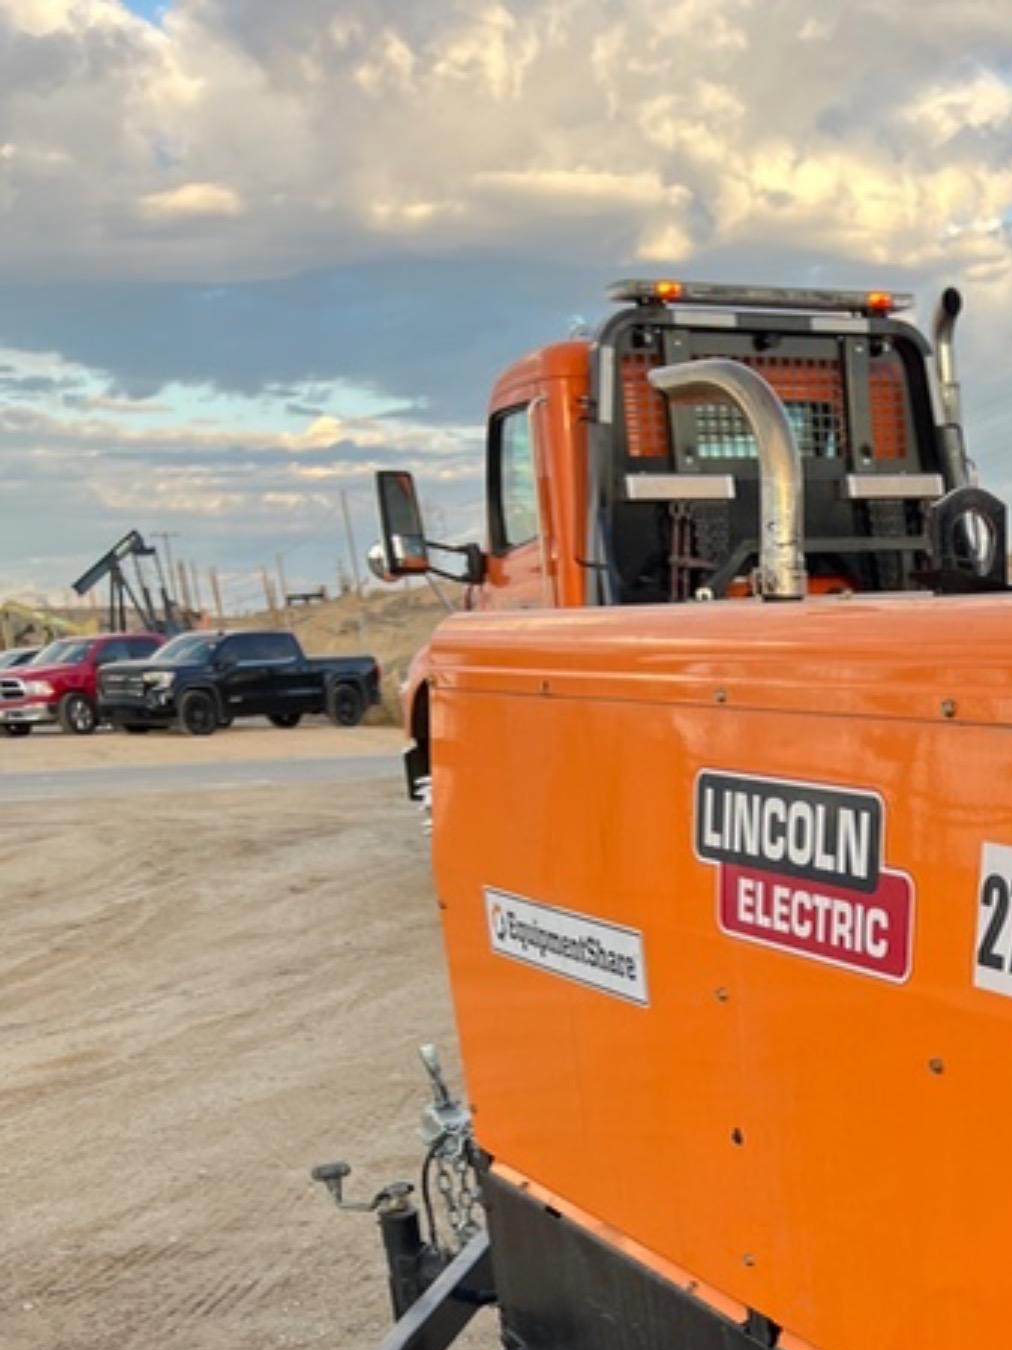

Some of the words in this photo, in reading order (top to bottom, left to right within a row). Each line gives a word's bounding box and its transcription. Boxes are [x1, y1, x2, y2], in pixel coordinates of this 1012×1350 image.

[704, 787, 871, 880] LINCOLN
[506, 911, 637, 982] EquipmentShare
[737, 876, 889, 959] ELECTRIC
